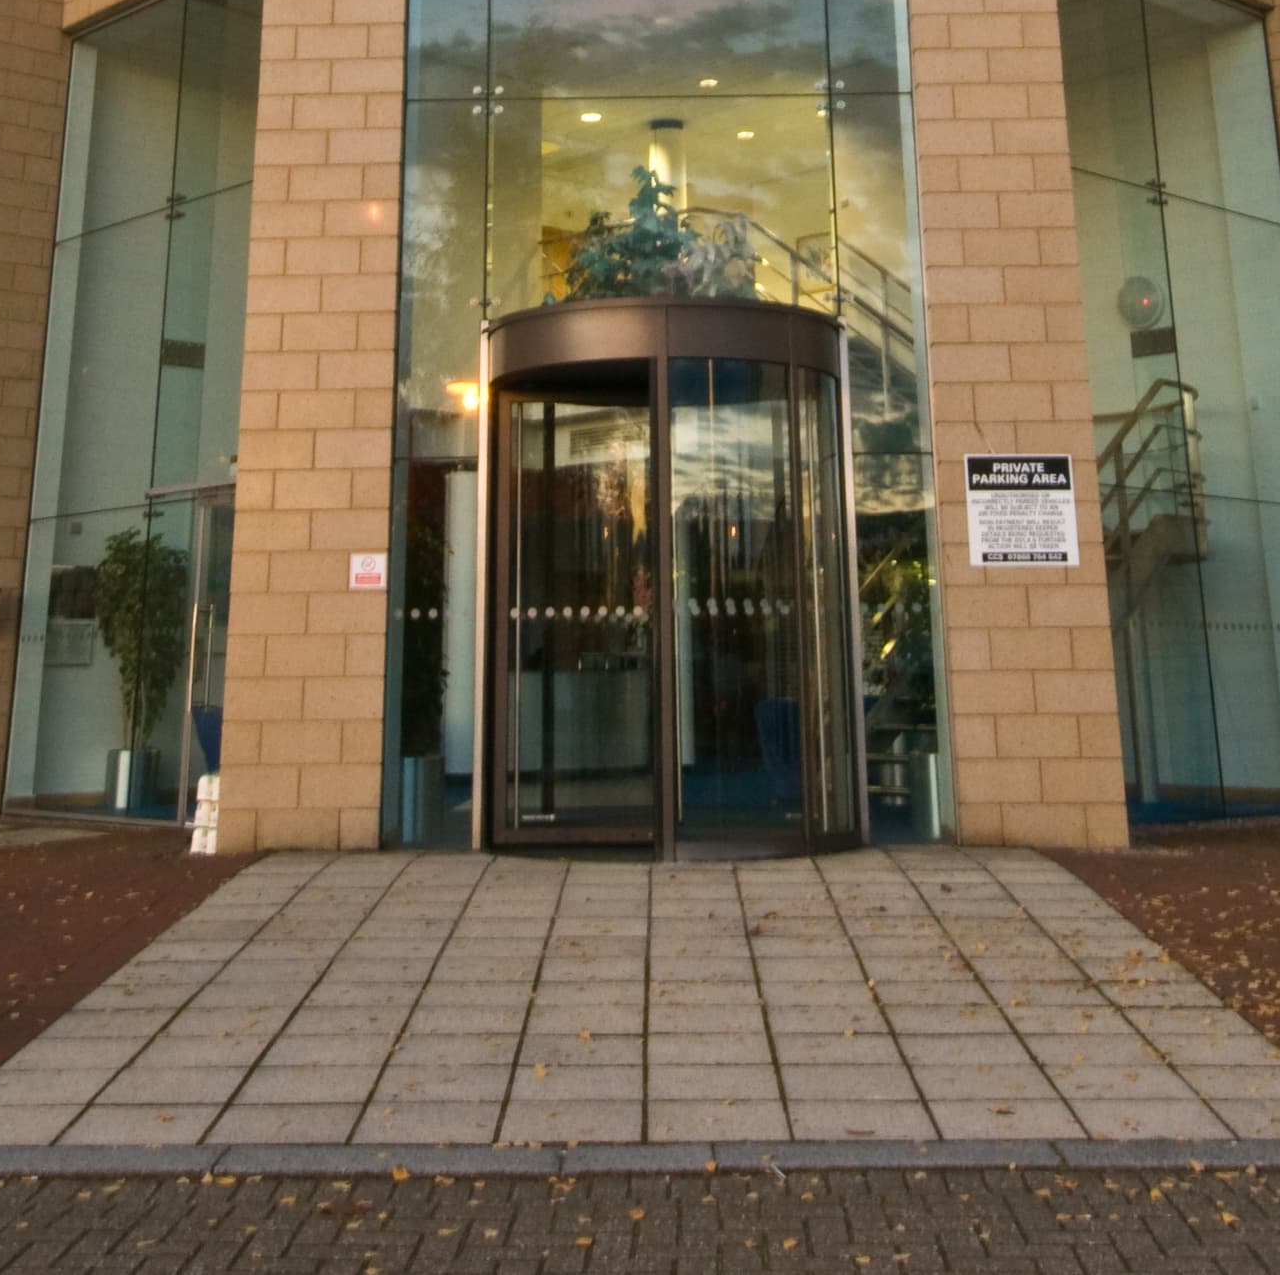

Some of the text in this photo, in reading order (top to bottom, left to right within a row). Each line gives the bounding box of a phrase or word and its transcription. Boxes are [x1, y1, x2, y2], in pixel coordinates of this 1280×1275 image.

[992, 462, 1045, 473] PRIVATE
[972, 474, 1067, 484] PARKING AREA
